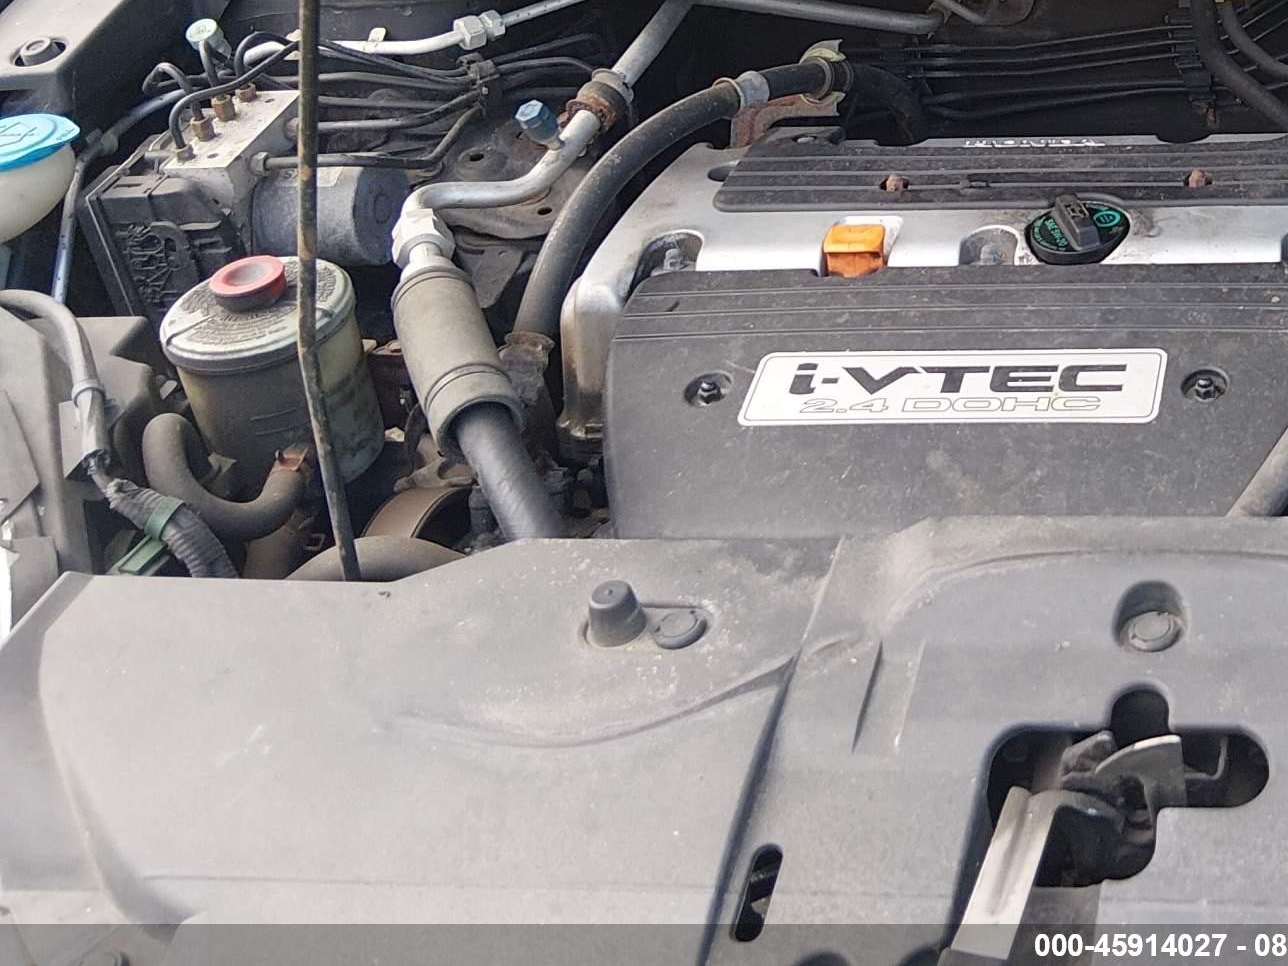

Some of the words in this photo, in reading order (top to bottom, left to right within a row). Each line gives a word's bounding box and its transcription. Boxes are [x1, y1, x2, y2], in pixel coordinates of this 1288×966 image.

[788, 362, 1128, 396] i-VTEC
[799, 397, 889, 413] 2.4
[900, 396, 1102, 413] DOHC
